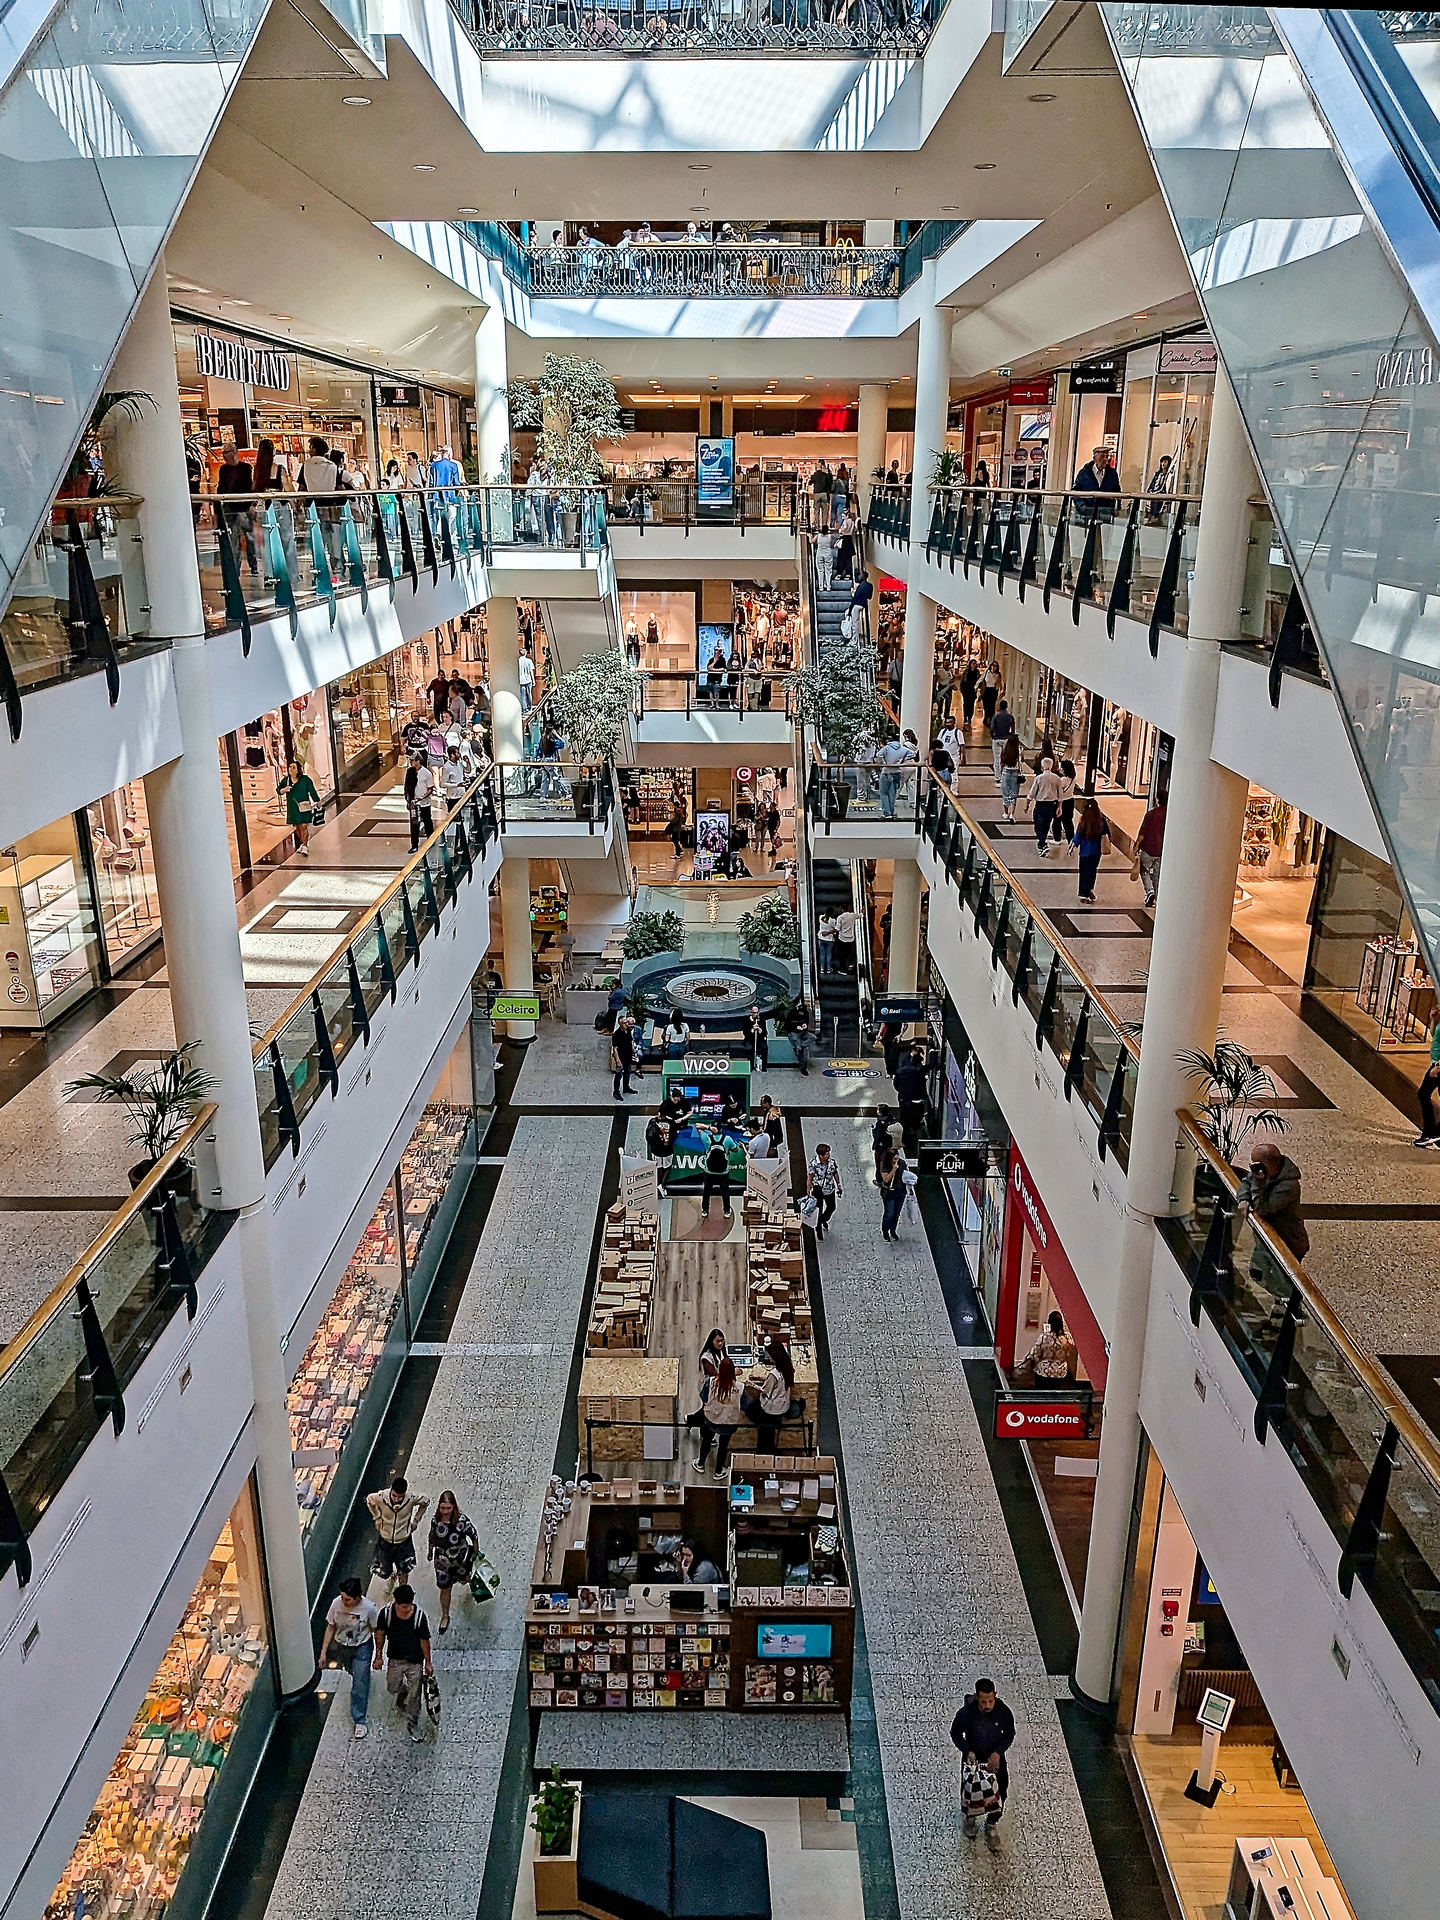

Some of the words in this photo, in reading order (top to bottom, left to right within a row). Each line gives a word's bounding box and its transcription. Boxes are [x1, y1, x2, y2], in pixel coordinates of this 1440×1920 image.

[197, 334, 290, 391] BERTRAND
[496, 1004, 535, 1014] Celeiro
[683, 1058, 729, 1072] WOO
[936, 1161, 965, 1170] PLURI
[1022, 1181, 1048, 1248] vodafone
[1027, 1414, 1079, 1424] vodafone
